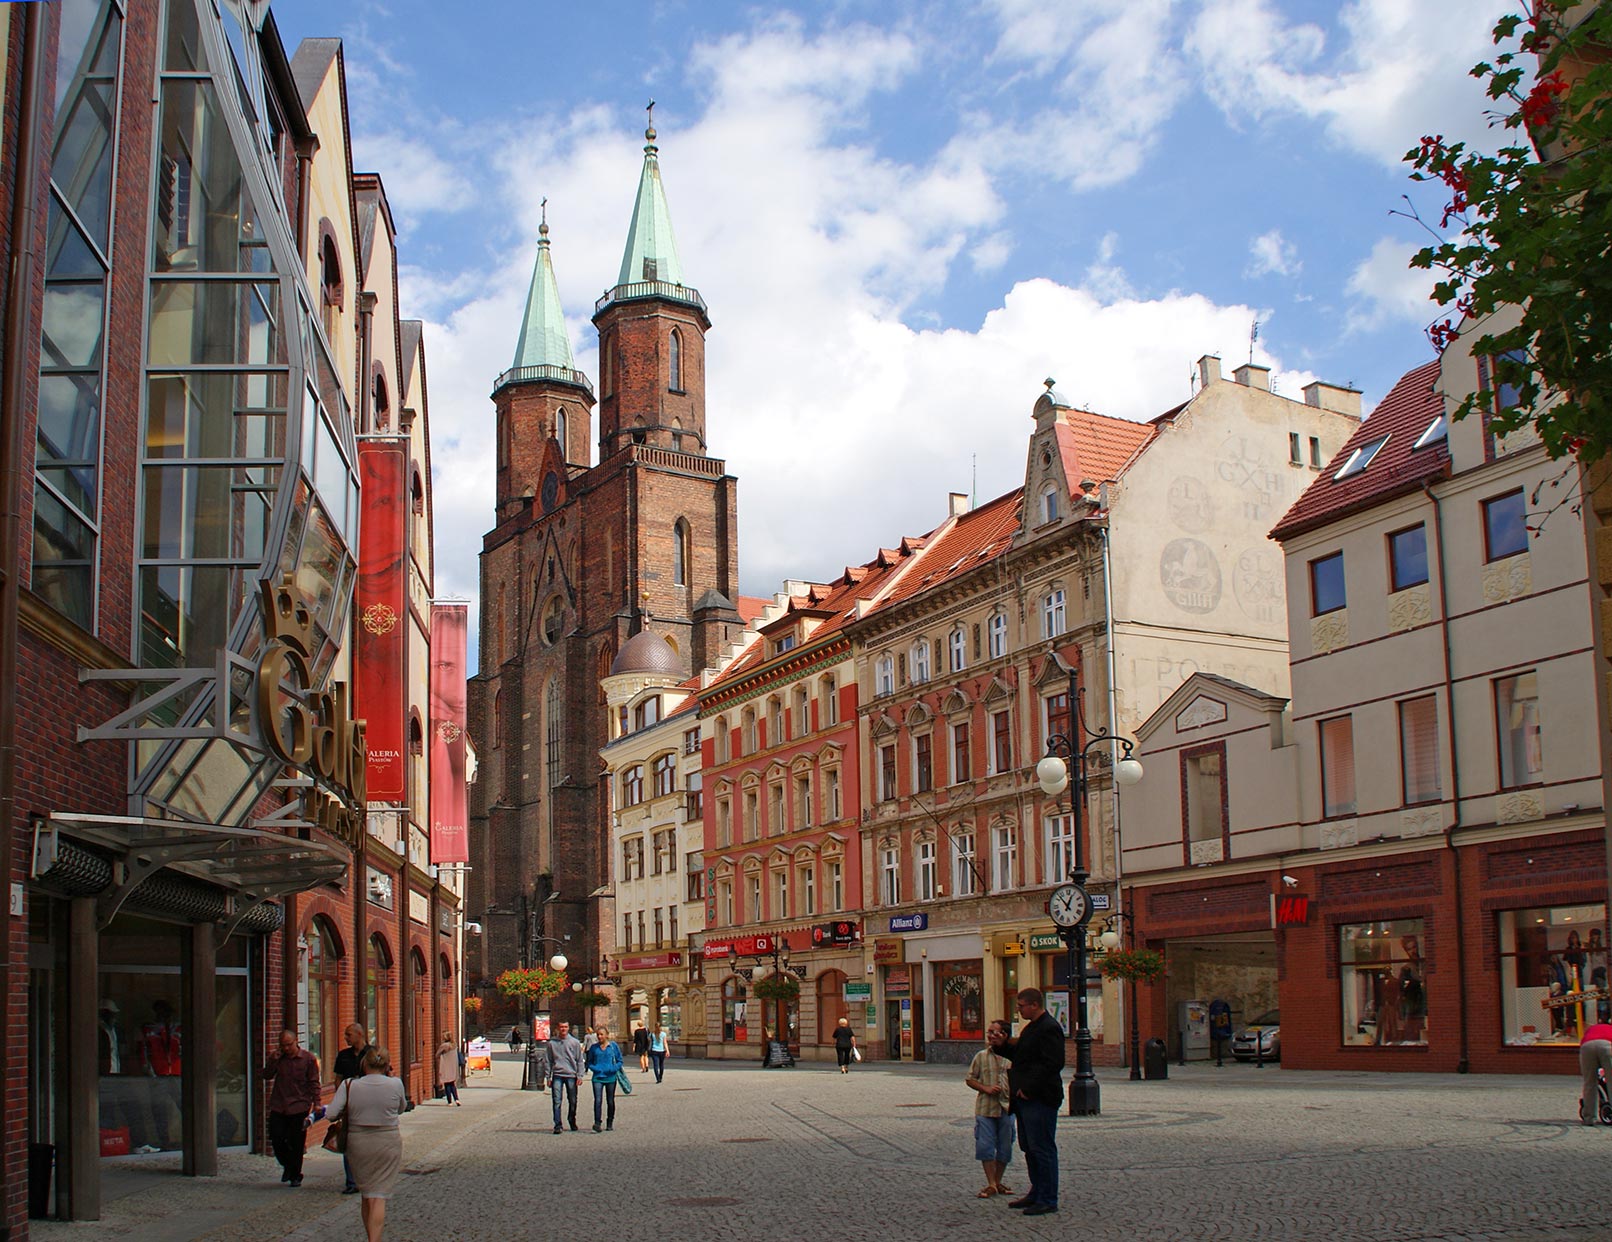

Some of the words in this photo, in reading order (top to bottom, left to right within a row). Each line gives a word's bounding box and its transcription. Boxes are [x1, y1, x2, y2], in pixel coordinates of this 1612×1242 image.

[366, 748, 400, 757] ALERIA
[892, 919, 913, 929] Allianz
[1039, 937, 1058, 946] SKOK
